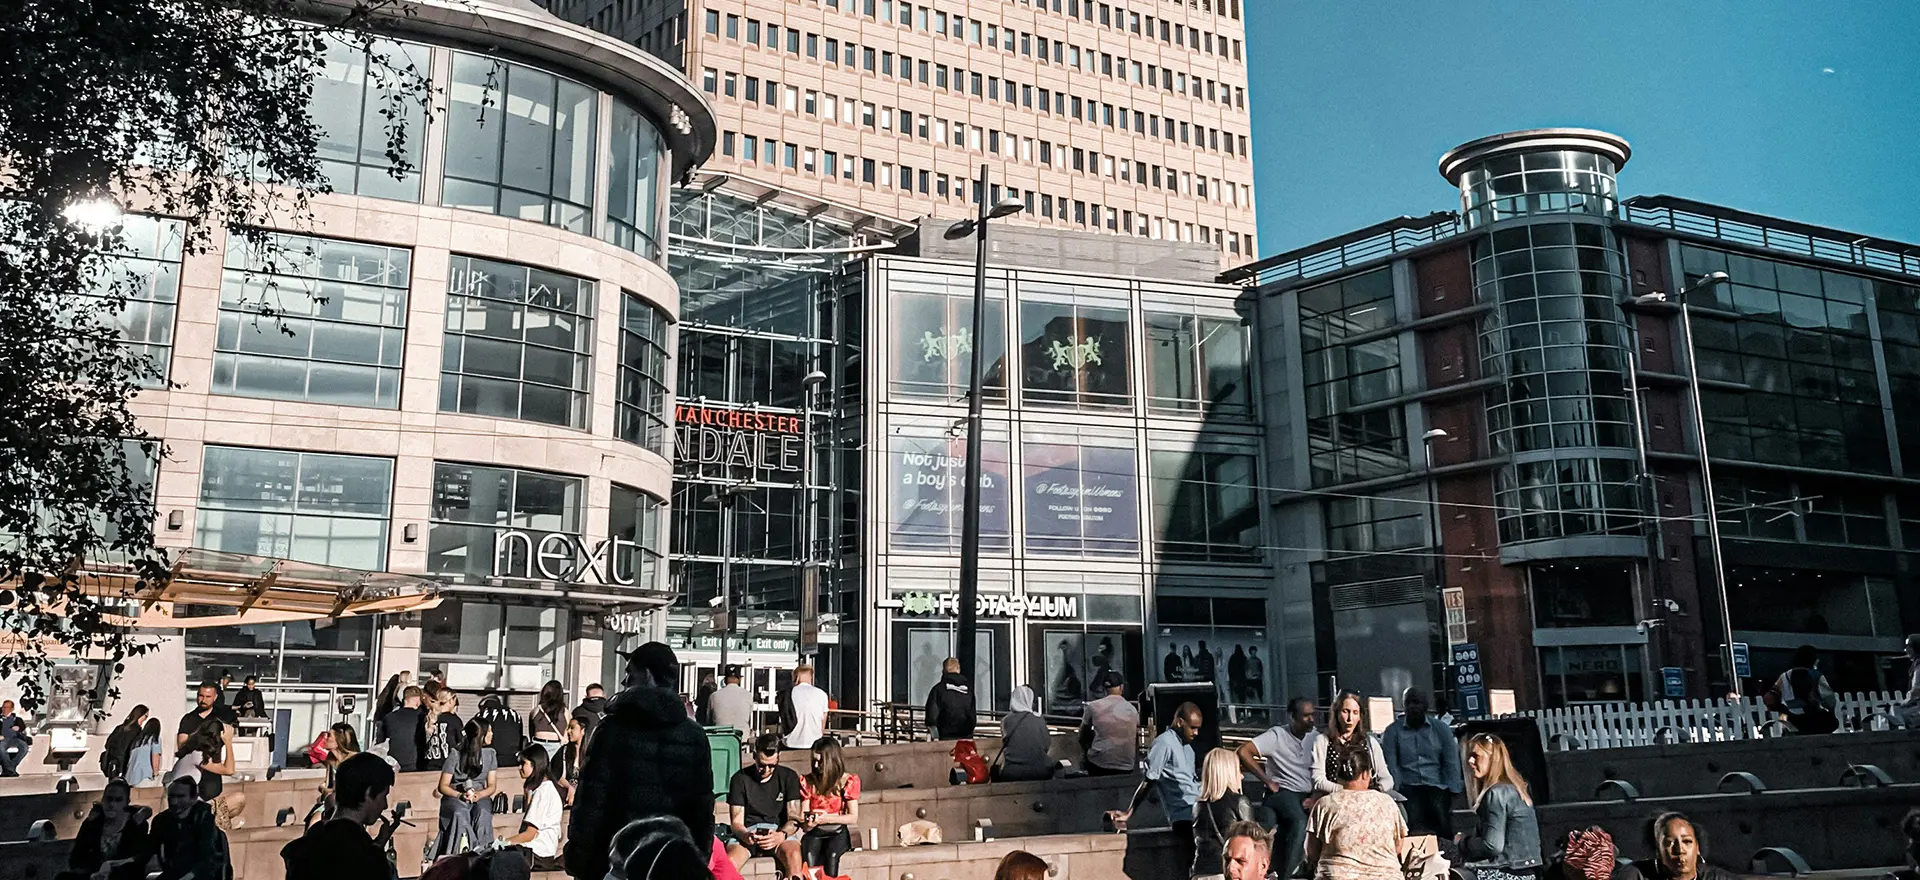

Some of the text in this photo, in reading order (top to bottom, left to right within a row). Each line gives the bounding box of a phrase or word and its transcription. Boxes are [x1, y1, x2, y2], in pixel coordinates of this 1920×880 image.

[675, 405, 799, 434] MANCHESTER
[903, 451, 966, 471] Not just
[903, 473, 913, 484] a
[917, 471, 957, 490] boy's
[494, 530, 636, 585] next
[701, 636, 717, 648] Exit
[756, 638, 790, 651] Exit only
[1568, 660, 1618, 671] NERO
